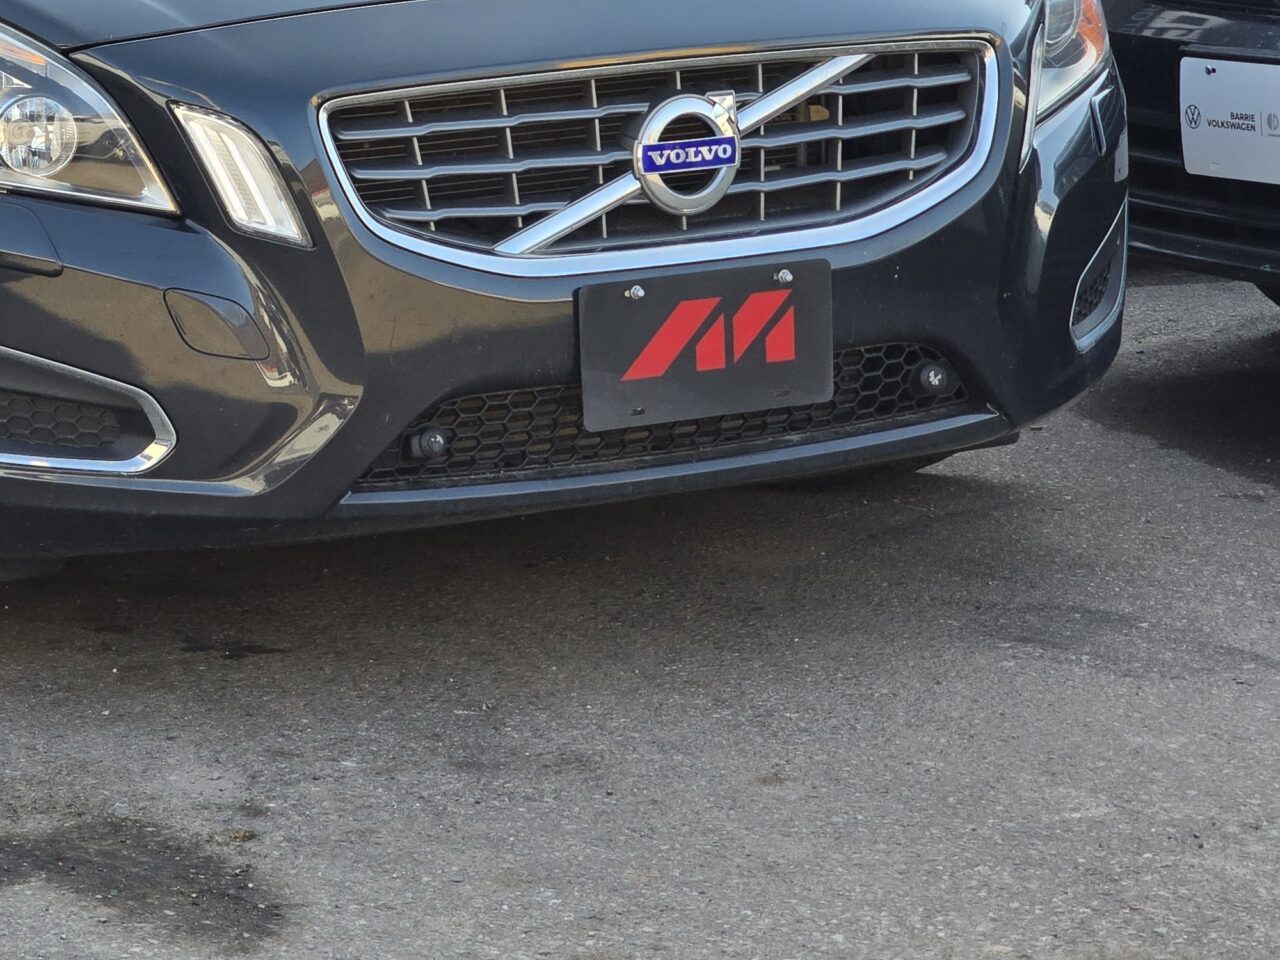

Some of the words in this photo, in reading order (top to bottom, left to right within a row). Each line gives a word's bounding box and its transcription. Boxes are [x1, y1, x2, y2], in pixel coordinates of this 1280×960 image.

[1230, 112, 1256, 122] BARRIE
[1207, 119, 1256, 132] VOLKSWAGEN
[647, 143, 733, 167] VOLVO
